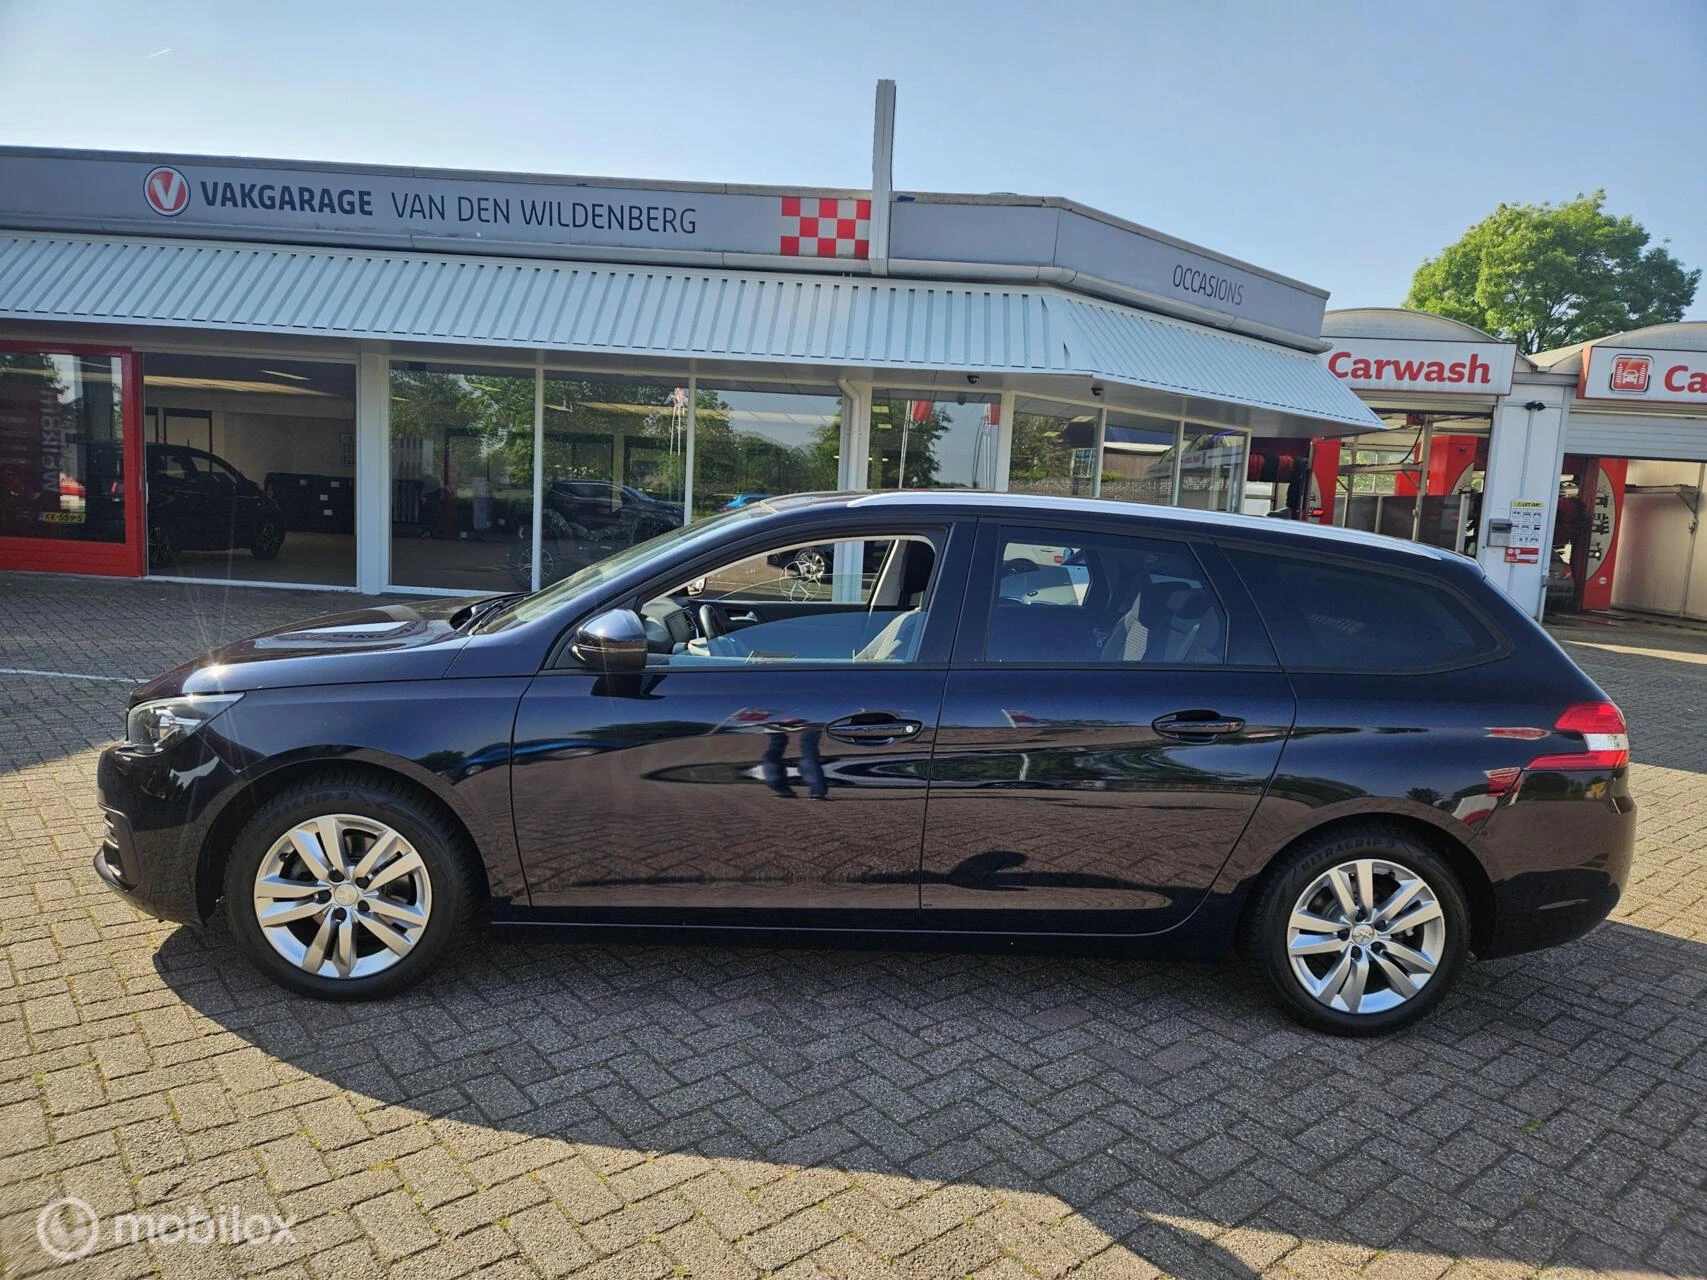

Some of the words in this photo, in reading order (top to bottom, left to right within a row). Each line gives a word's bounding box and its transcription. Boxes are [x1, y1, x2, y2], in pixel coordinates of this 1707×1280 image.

[200, 180, 373, 216] VAKGARAGE
[391, 192, 446, 221] VAN
[457, 196, 510, 224] DEN
[520, 200, 697, 234] WILDENBERG
[1173, 264, 1244, 306] OCCASIONS
[1328, 351, 1491, 384] Carwash
